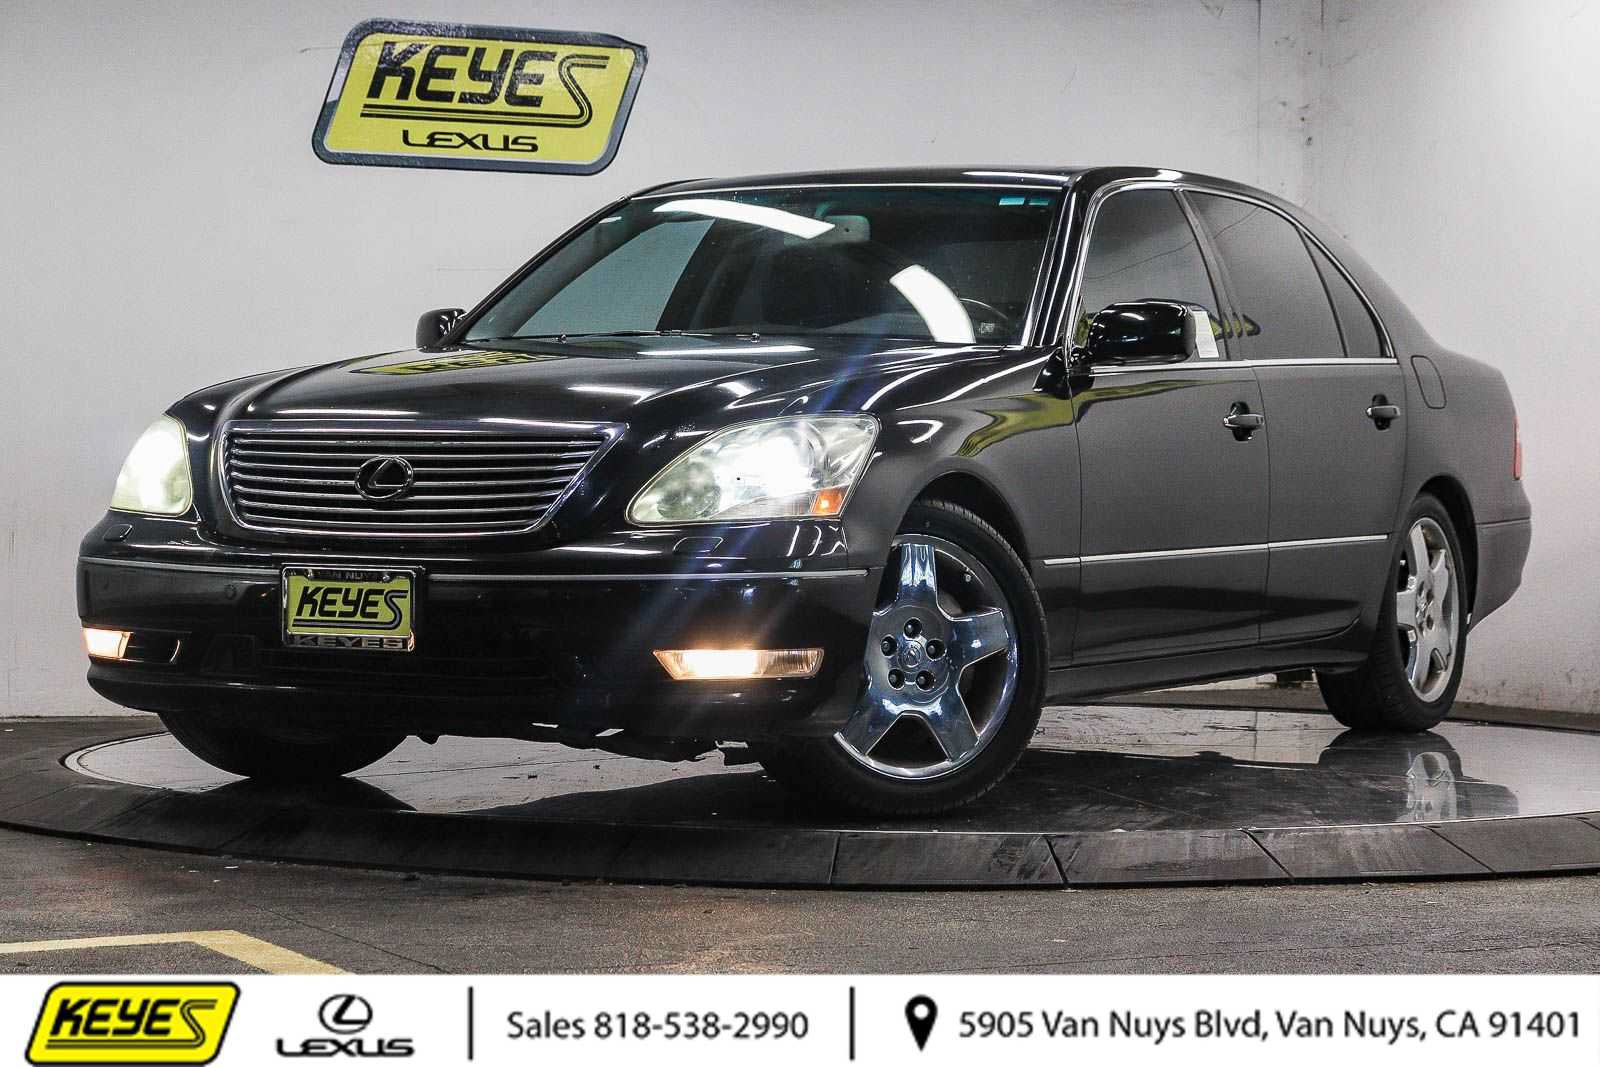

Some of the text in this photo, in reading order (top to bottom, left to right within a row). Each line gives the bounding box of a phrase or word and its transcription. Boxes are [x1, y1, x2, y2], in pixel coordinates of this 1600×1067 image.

[363, 41, 610, 127] KEYES
[402, 130, 539, 152] LEXUS
[294, 586, 409, 629] KEYES
[295, 635, 403, 649] KEYES
